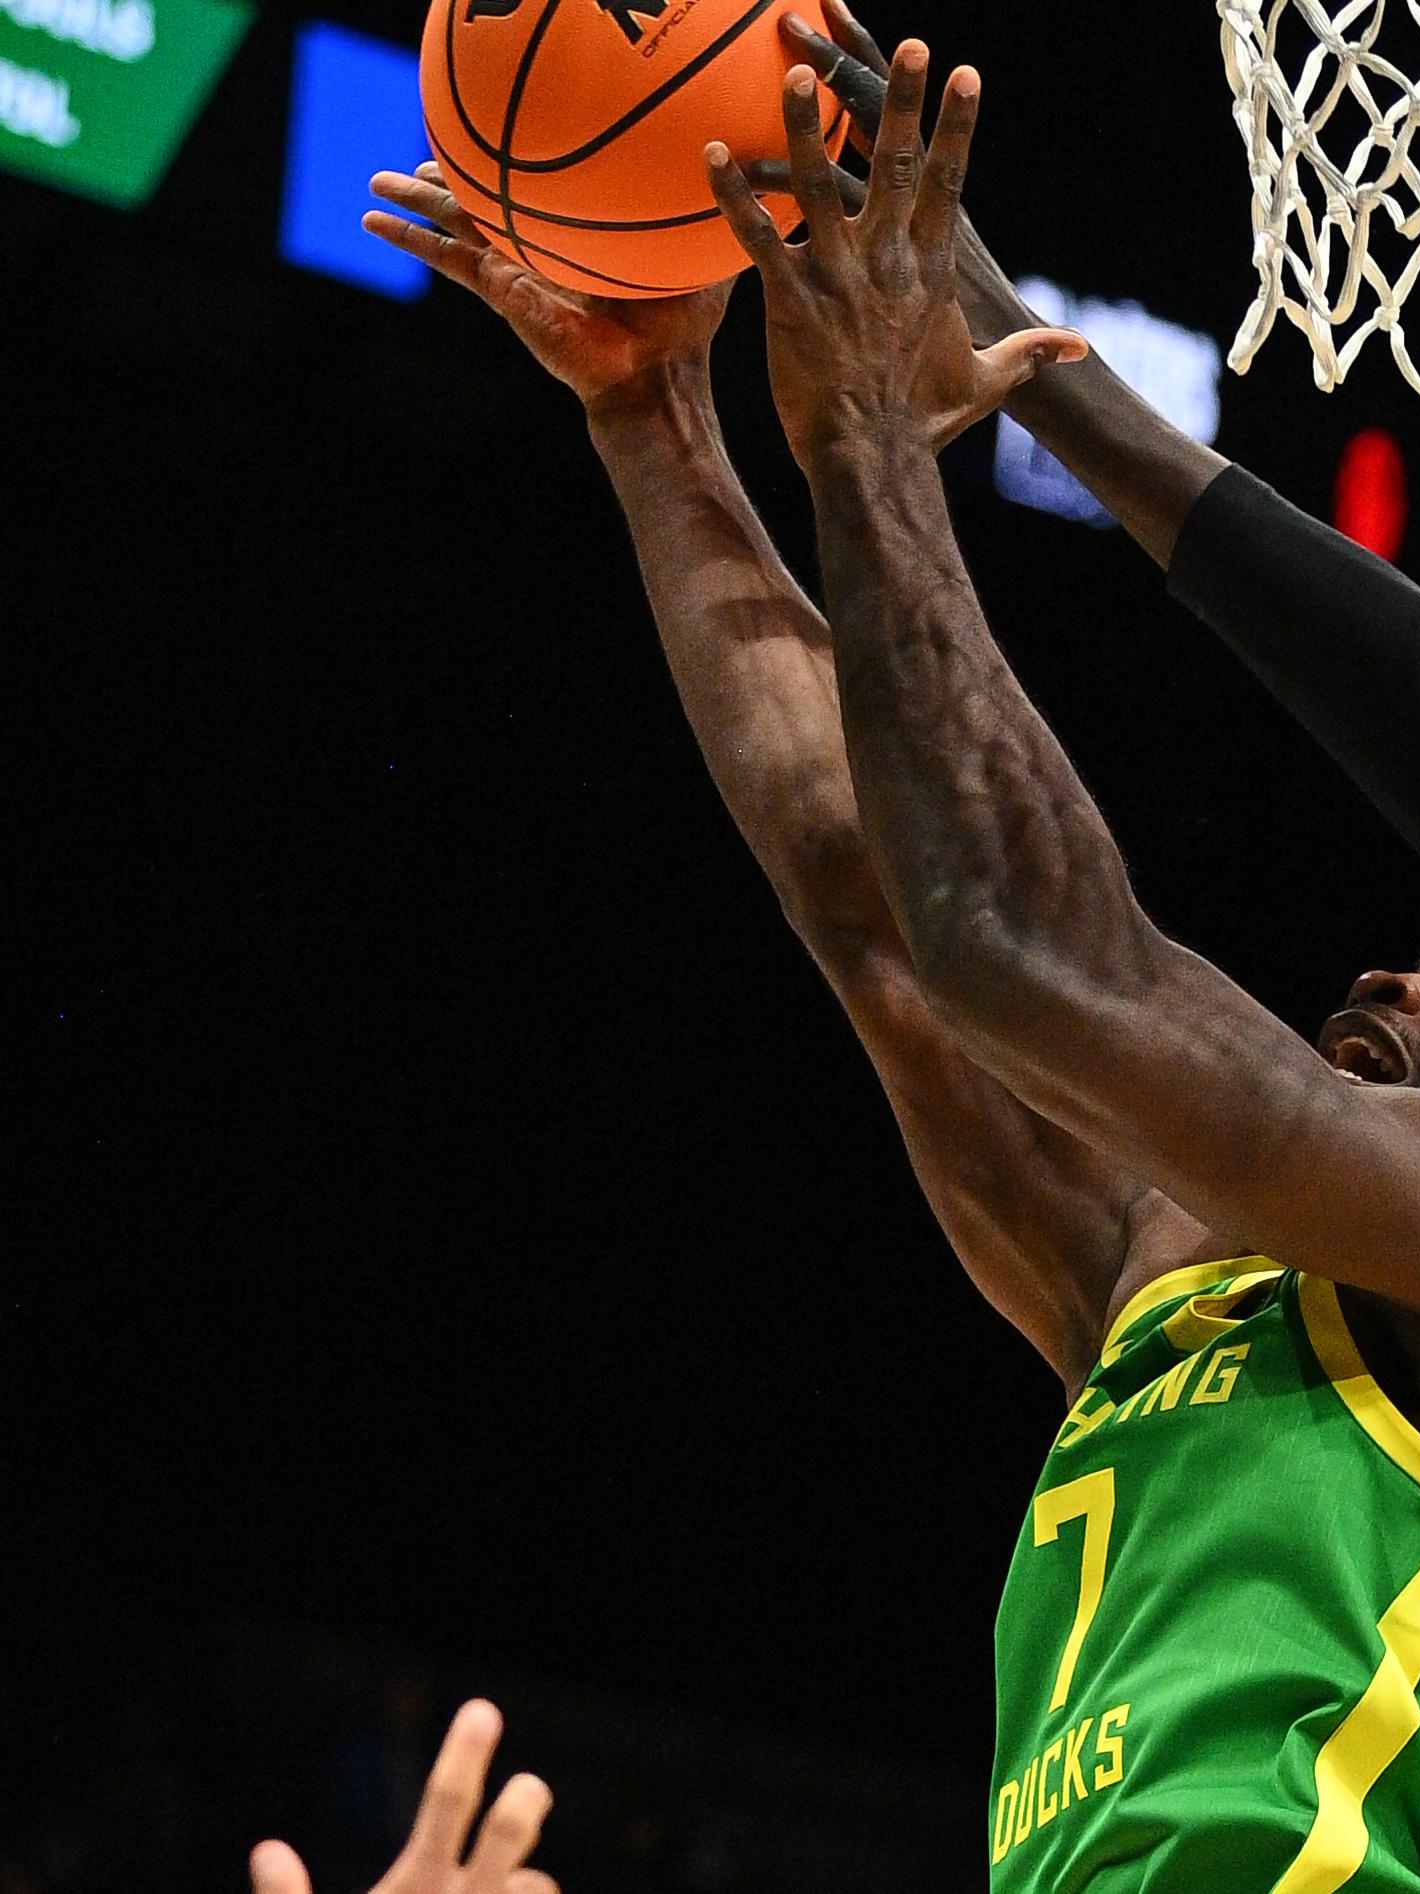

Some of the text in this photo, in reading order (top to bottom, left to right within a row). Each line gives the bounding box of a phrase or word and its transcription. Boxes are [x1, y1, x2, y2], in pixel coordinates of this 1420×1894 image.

[641, 0, 700, 58] OFFICIA
[1034, 1467, 1115, 1713] 7
[992, 1703, 1131, 1866] DUCKS
